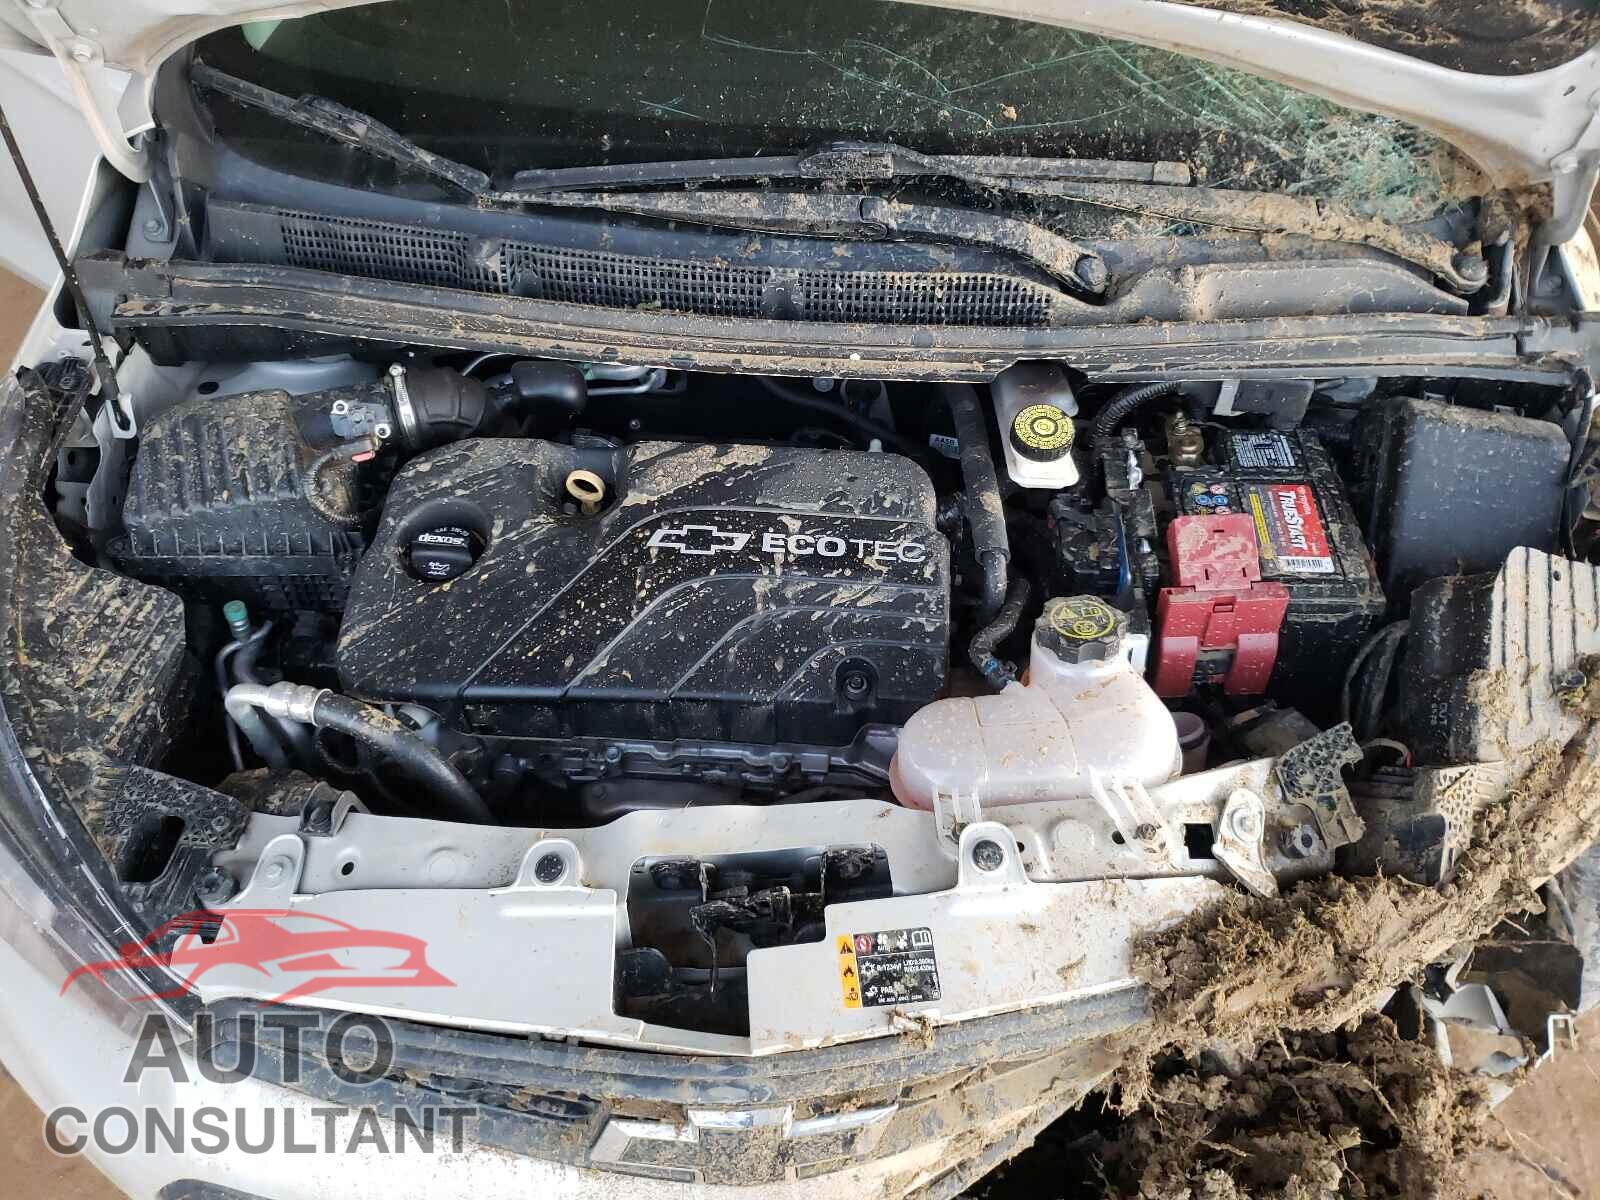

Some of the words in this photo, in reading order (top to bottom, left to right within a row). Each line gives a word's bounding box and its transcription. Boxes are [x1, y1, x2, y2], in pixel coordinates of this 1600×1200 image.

[1279, 490, 1308, 551] TRUESTART
[418, 533, 465, 545] dexos
[761, 532, 926, 563] ECOTEC
